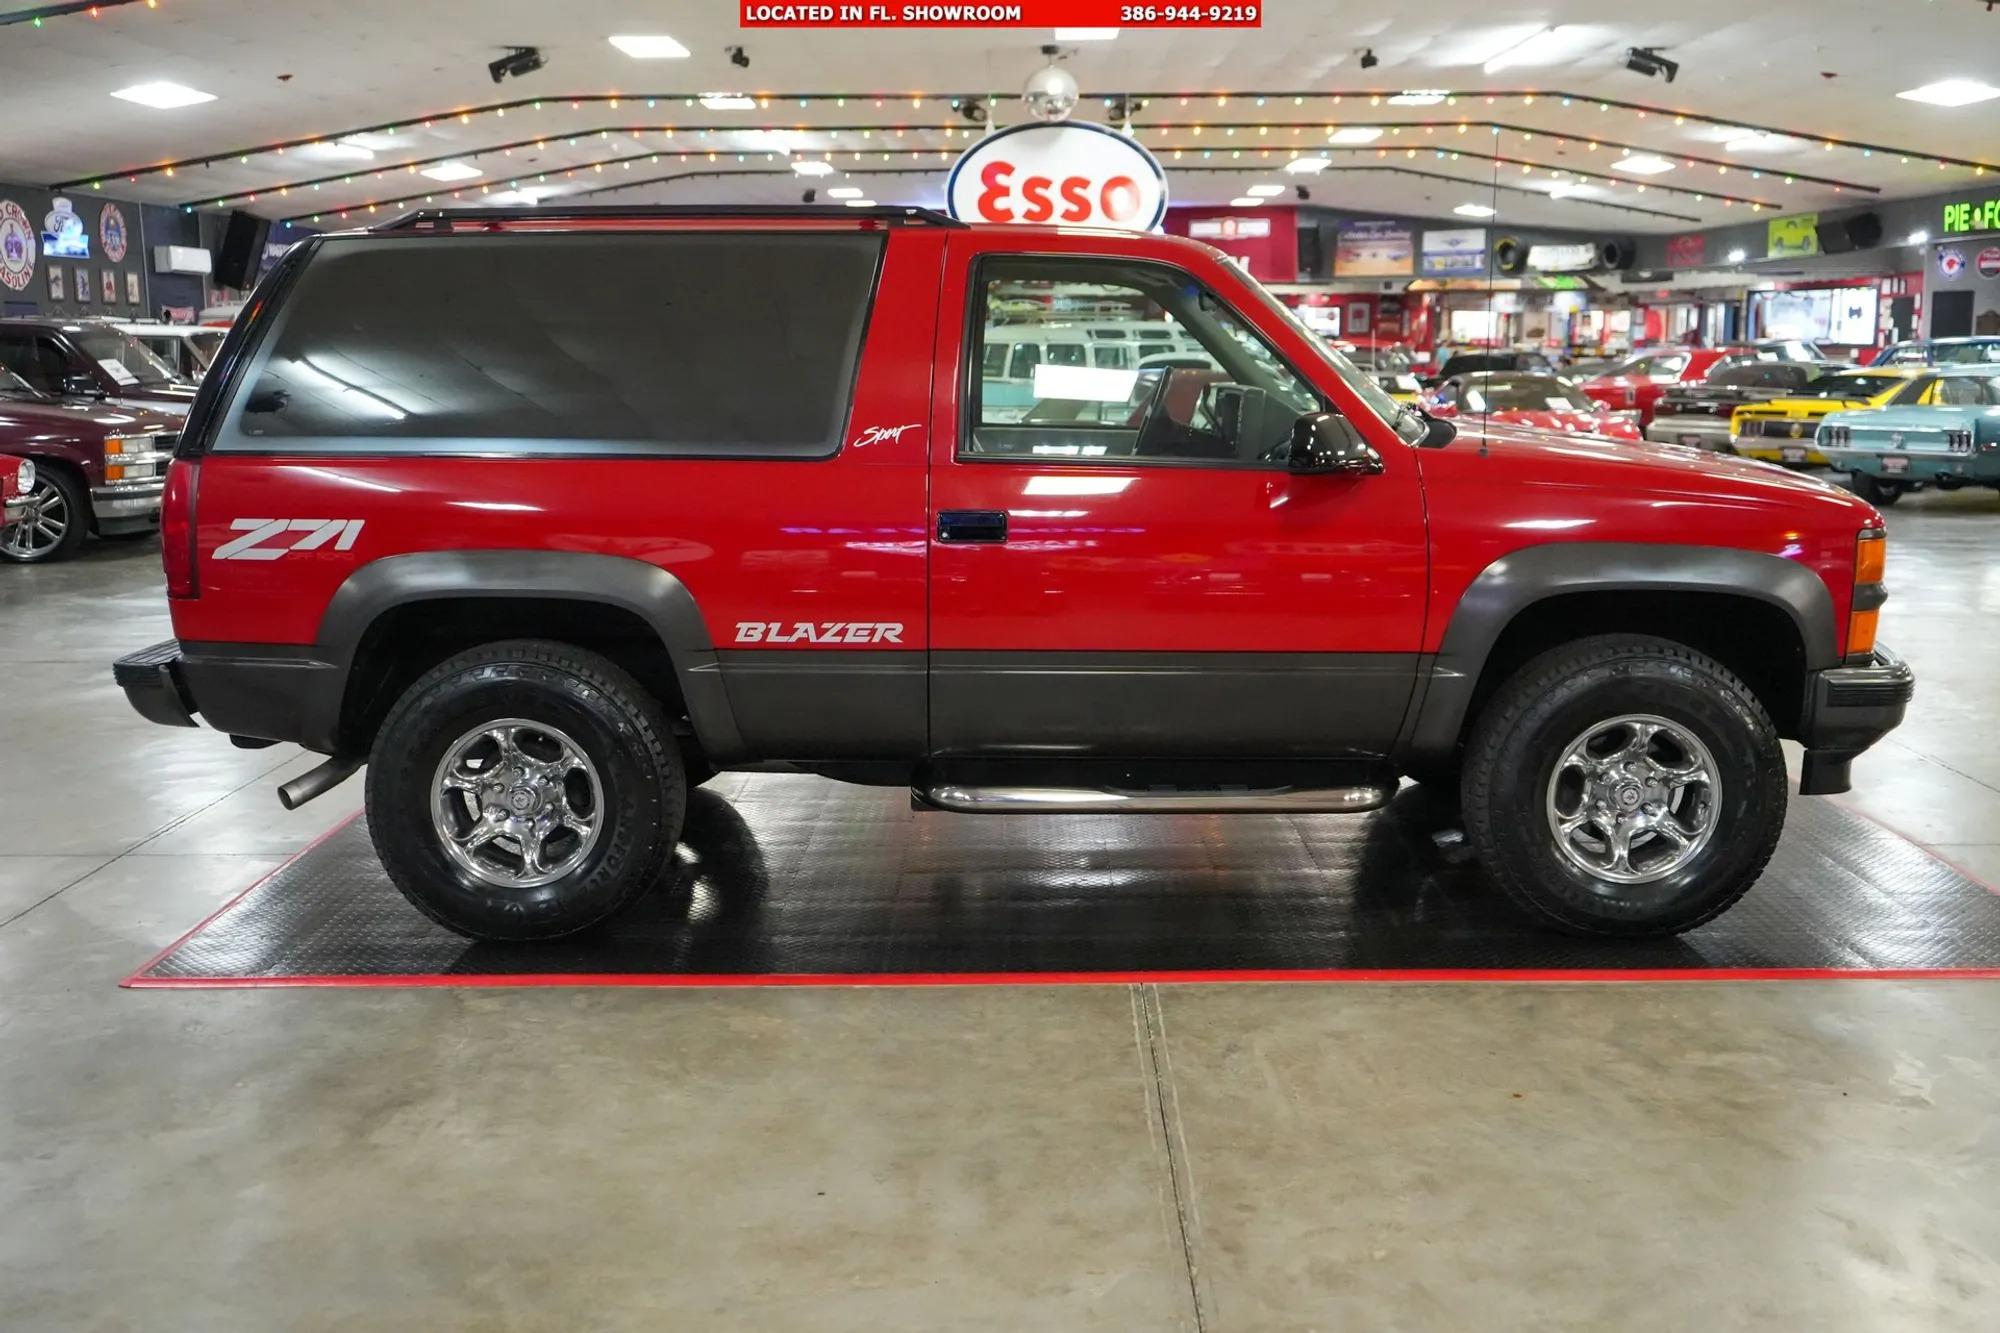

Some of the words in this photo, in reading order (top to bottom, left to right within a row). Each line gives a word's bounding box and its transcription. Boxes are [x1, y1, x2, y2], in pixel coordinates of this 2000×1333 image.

[1944, 202, 1971, 233] PIE
[0, 259, 34, 288] ASOLINE
[211, 518, 366, 561] Z71
[735, 622, 904, 643] BLAZER
